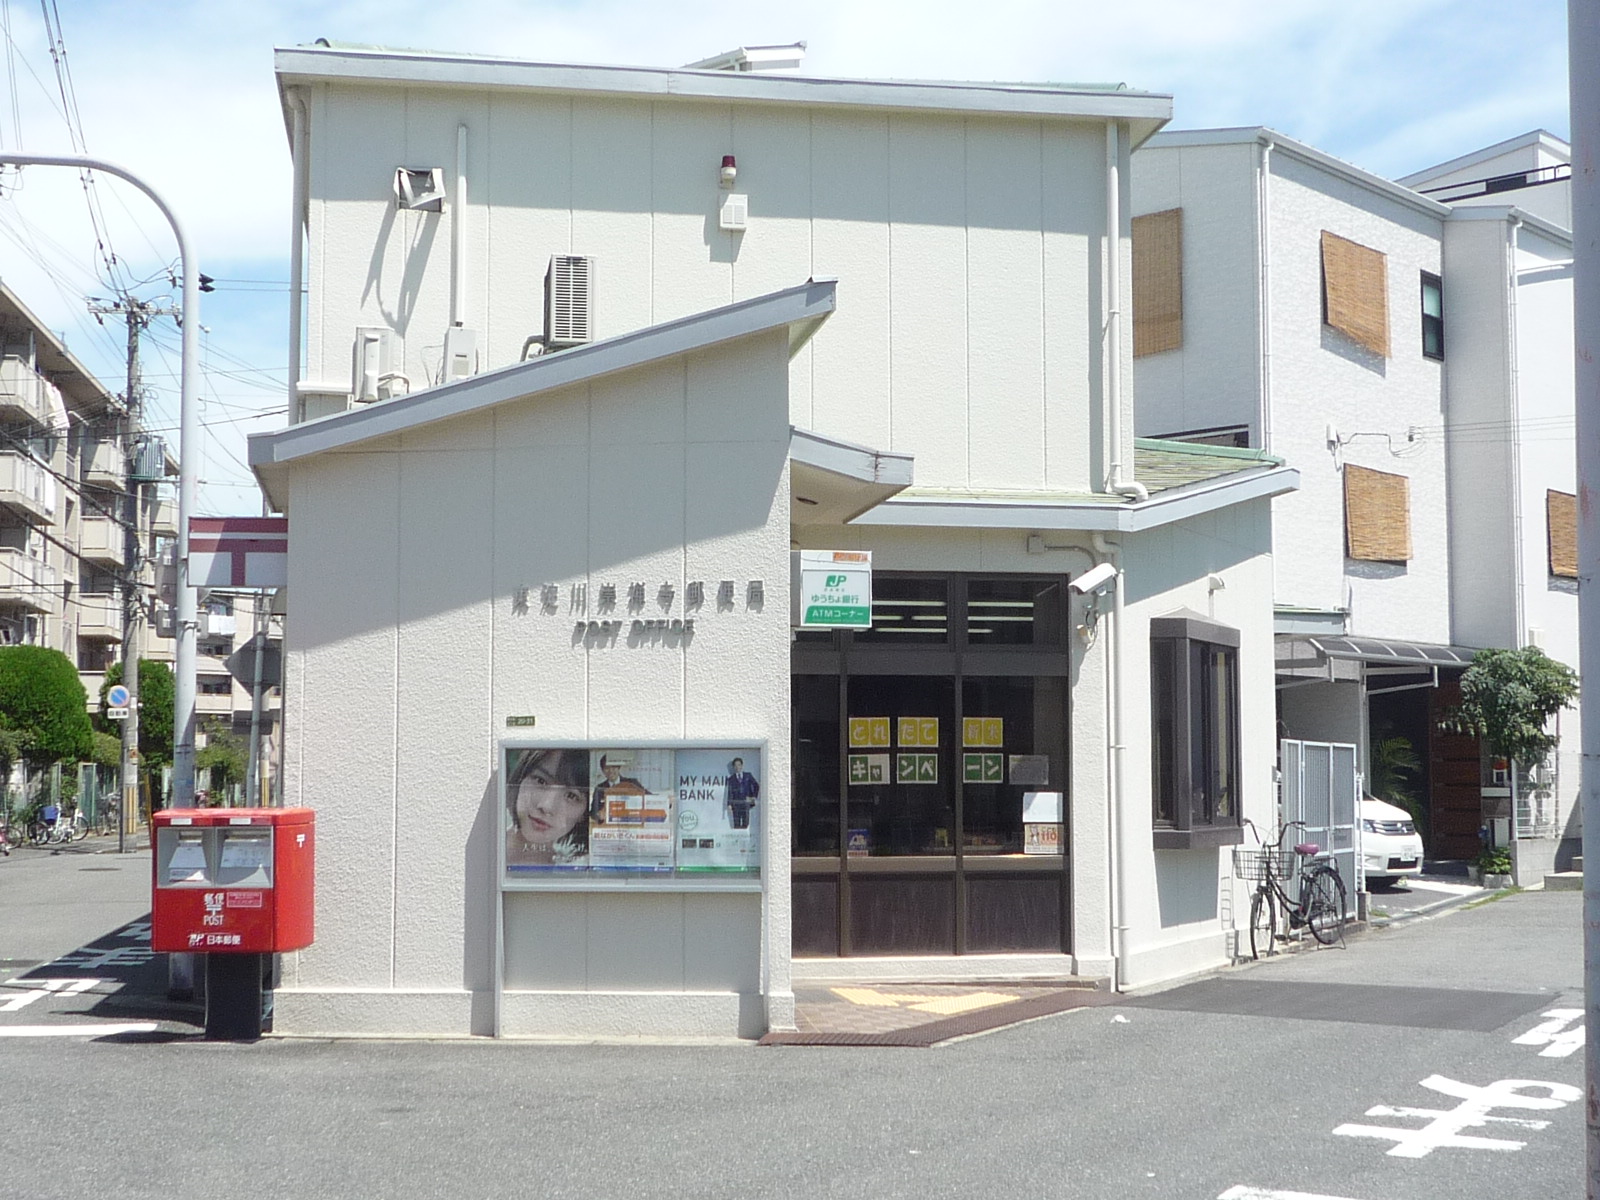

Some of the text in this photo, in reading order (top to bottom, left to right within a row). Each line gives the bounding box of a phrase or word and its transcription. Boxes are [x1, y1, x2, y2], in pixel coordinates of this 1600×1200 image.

[811, 594, 859, 604] ゆうちょ銀行
[812, 609, 864, 618] ATMコーナー
[574, 619, 695, 641] POST OFFICE
[680, 775, 697, 786] MY
[680, 789, 715, 800] BANK
[203, 915, 224, 926] POST
[206, 934, 241, 945] 日本郵便
